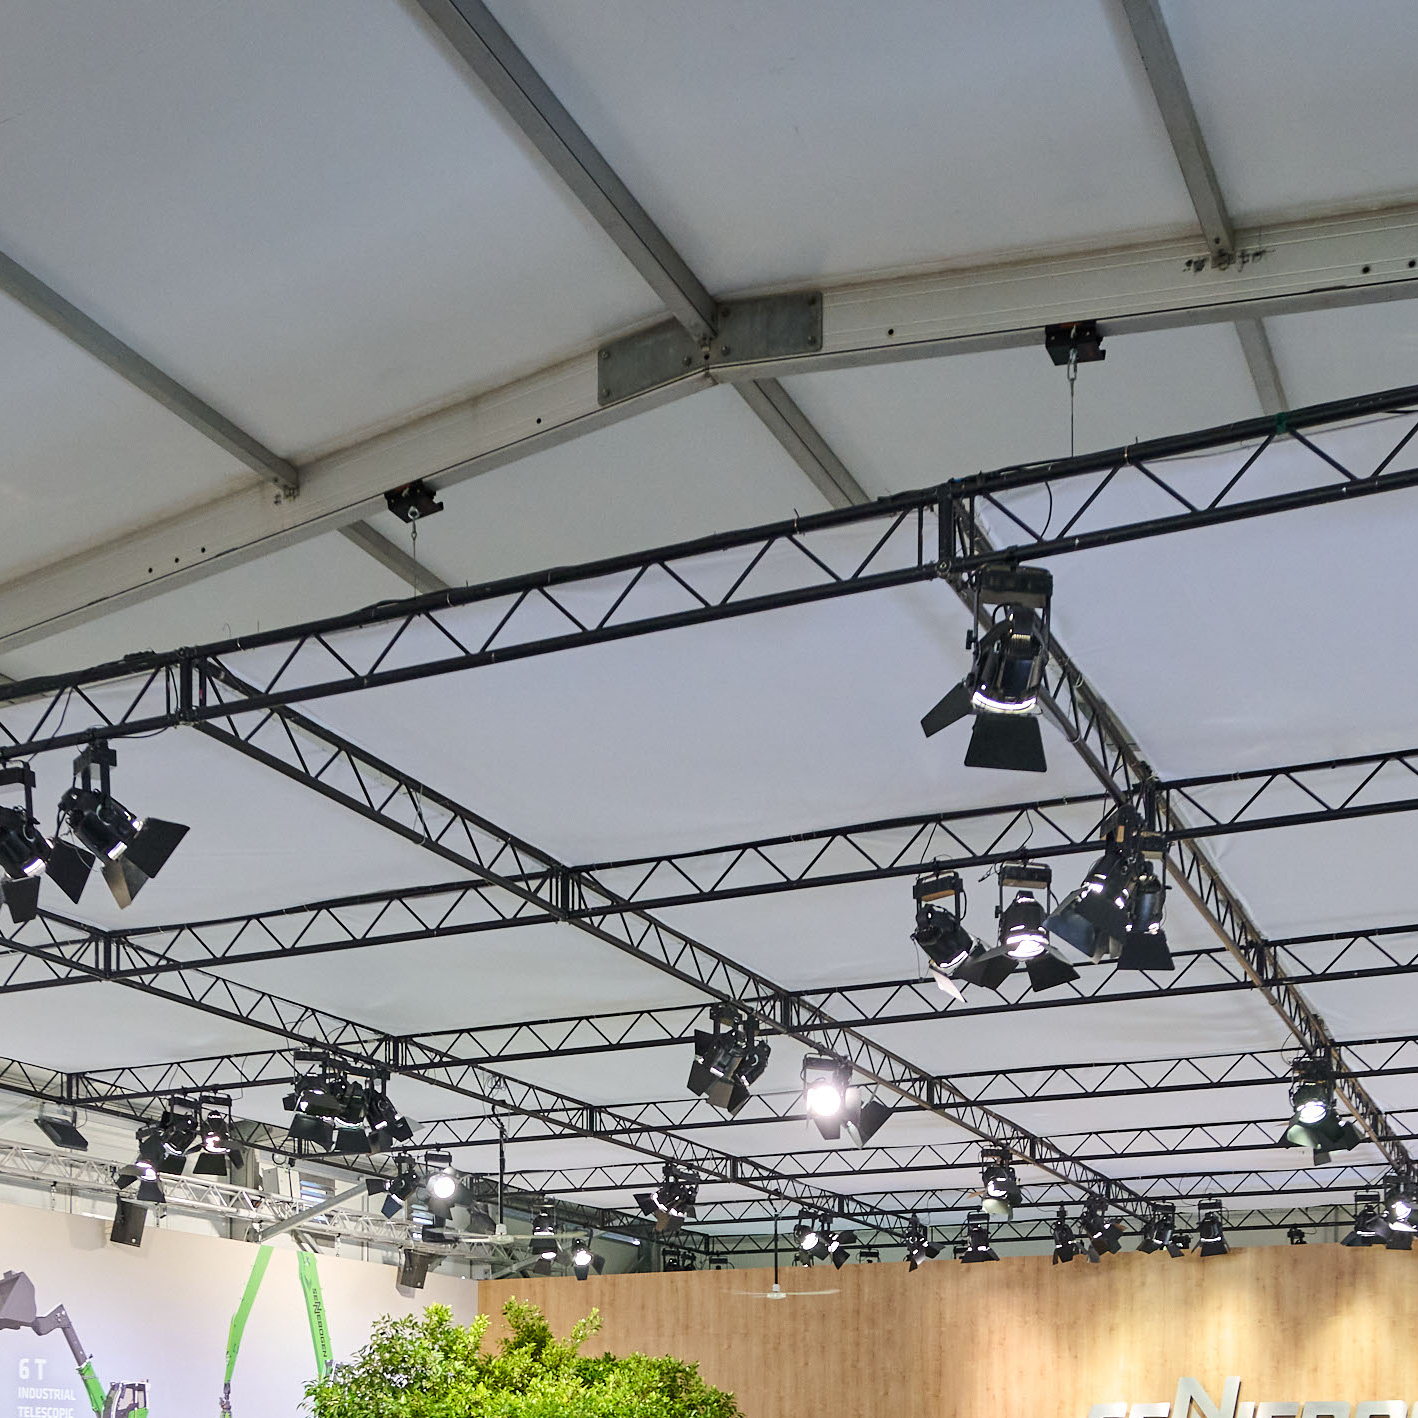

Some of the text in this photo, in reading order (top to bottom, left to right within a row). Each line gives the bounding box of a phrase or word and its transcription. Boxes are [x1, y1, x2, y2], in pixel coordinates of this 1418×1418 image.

[18, 1358, 47, 1380] 6 T
[18, 1387, 76, 1401] INDUSTRIAL
[17, 1406, 75, 1418] TELESCOPIC
